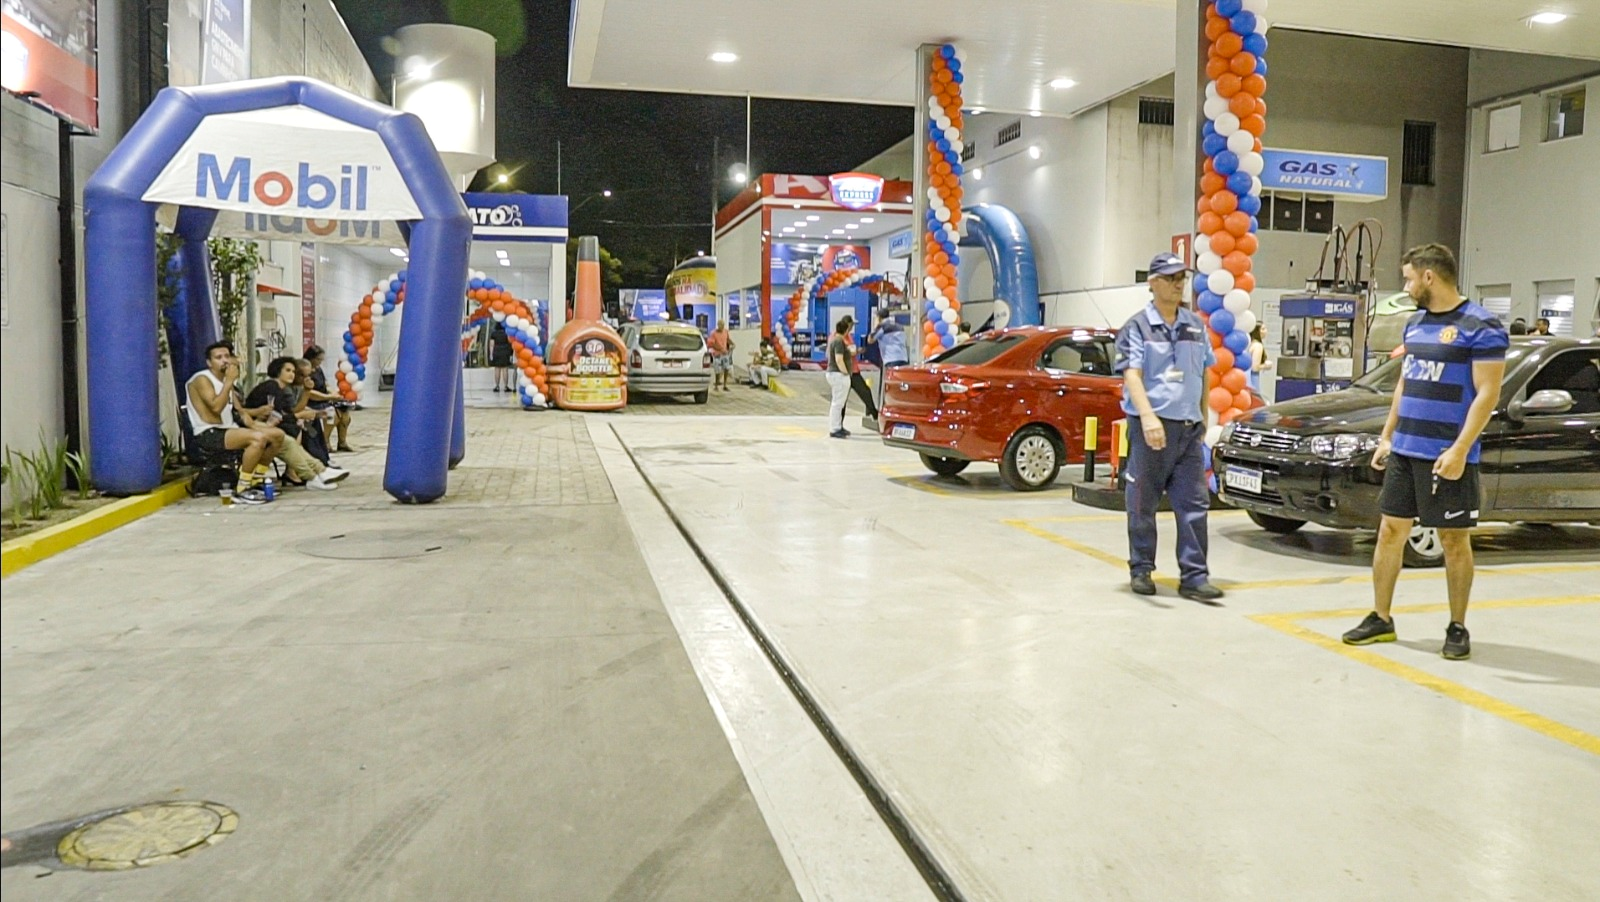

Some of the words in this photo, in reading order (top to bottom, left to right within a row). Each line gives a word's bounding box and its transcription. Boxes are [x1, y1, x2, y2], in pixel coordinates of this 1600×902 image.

[1279, 160, 1338, 176] GAS
[195, 152, 369, 211] Mobil
[1280, 175, 1352, 189] NATURAL
